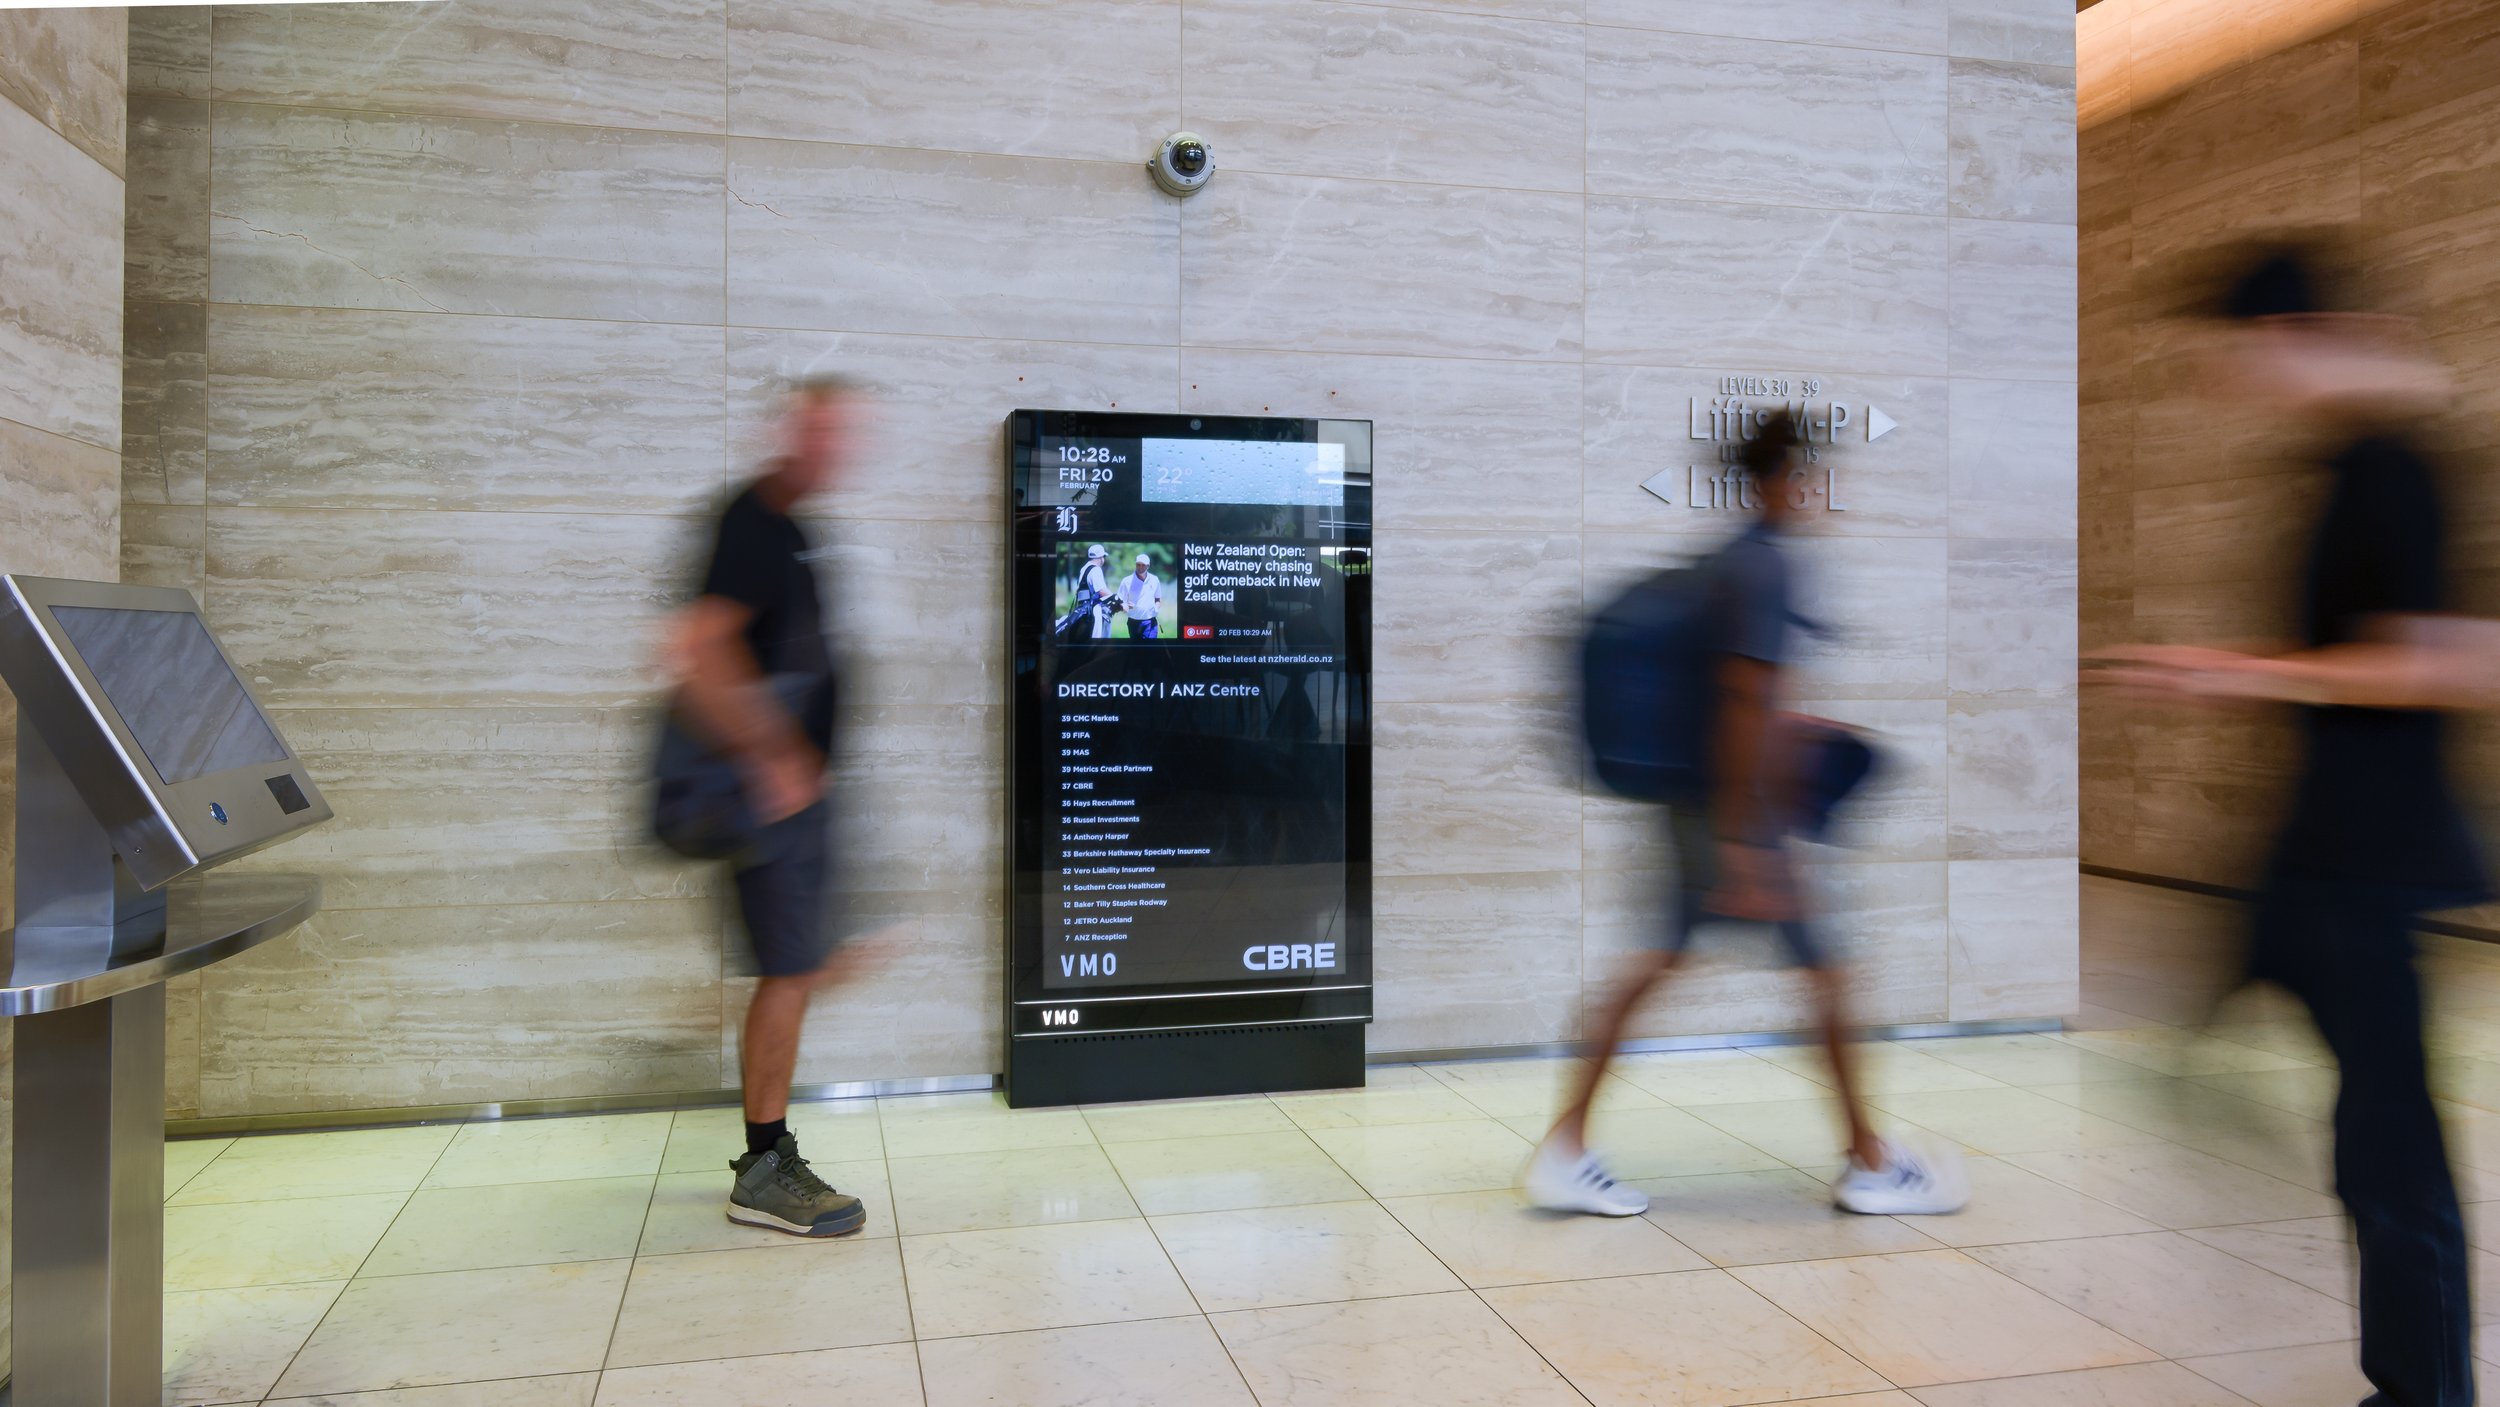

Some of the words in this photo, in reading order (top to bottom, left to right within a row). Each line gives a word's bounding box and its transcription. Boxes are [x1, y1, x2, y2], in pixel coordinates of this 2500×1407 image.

[1721, 377, 1769, 396] LEVELS
[1773, 378, 1790, 396] 30
[1801, 379, 1820, 398] 39
[1059, 446, 1110, 463] 10:28
[1112, 455, 1126, 464] AM
[1805, 448, 1820, 464] 15
[1059, 468, 1086, 482] FRI
[1091, 468, 1113, 482] 20
[1060, 482, 1100, 490] FEBRUARY
[1185, 543, 1213, 557] New
[1216, 543, 1266, 557] Zealand
[1270, 544, 1305, 557] Open:
[1185, 559, 1213, 572] Nick
[1216, 559, 1262, 575] Watney
[1265, 559, 1312, 575] chasing
[1185, 575, 1208, 588] golf
[1212, 575, 1276, 587] comeback
[1280, 575, 1289, 587] in
[1293, 576, 1321, 587] New
[1185, 590, 1234, 602] Zealand
[1200, 655, 1216, 663] See
[1218, 655, 1231, 663] the
[1233, 655, 1256, 663] latest
[1268, 655, 1333, 663] nzherald.co.nz
[1058, 684, 1154, 698] DIRECTORY
[1171, 684, 1205, 697] ANZ
[1210, 684, 1260, 697] Centre
[1073, 765, 1099, 773] Metrics
[1100, 765, 1122, 773] Credit
[1073, 782, 1094, 790] CBRE
[1073, 800, 1091, 808] Hays
[1062, 816, 1071, 824] 36
[1073, 816, 1096, 824] Russel
[1062, 833, 1072, 841] 34
[1073, 833, 1104, 842] Anthony
[1105, 832, 1129, 841] Harper
[1073, 849, 1107, 857] Berkshire
[1108, 848, 1142, 858] Hathaway
[1144, 848, 1176, 857] Specialty
[1177, 847, 1210, 855] Insurance
[1092, 865, 1121, 876] Liability
[1122, 865, 1155, 873] Insurance
[1063, 884, 1071, 892] 14
[1073, 883, 1106, 891] Southern
[1107, 883, 1127, 891] Cross
[1128, 881, 1165, 890] Healthcare
[1074, 900, 1094, 908] Baker
[1096, 900, 1111, 909] Tilly
[1112, 899, 1138, 908] Staples
[1139, 898, 1168, 908] Rodway
[1073, 917, 1098, 925] JETRO
[1099, 916, 1132, 924] Auckland
[1092, 933, 1127, 942] Reception
[1243, 942, 1335, 971] CBRE
[1061, 952, 1117, 977] VMO
[1042, 1009, 1079, 1026] VMO
